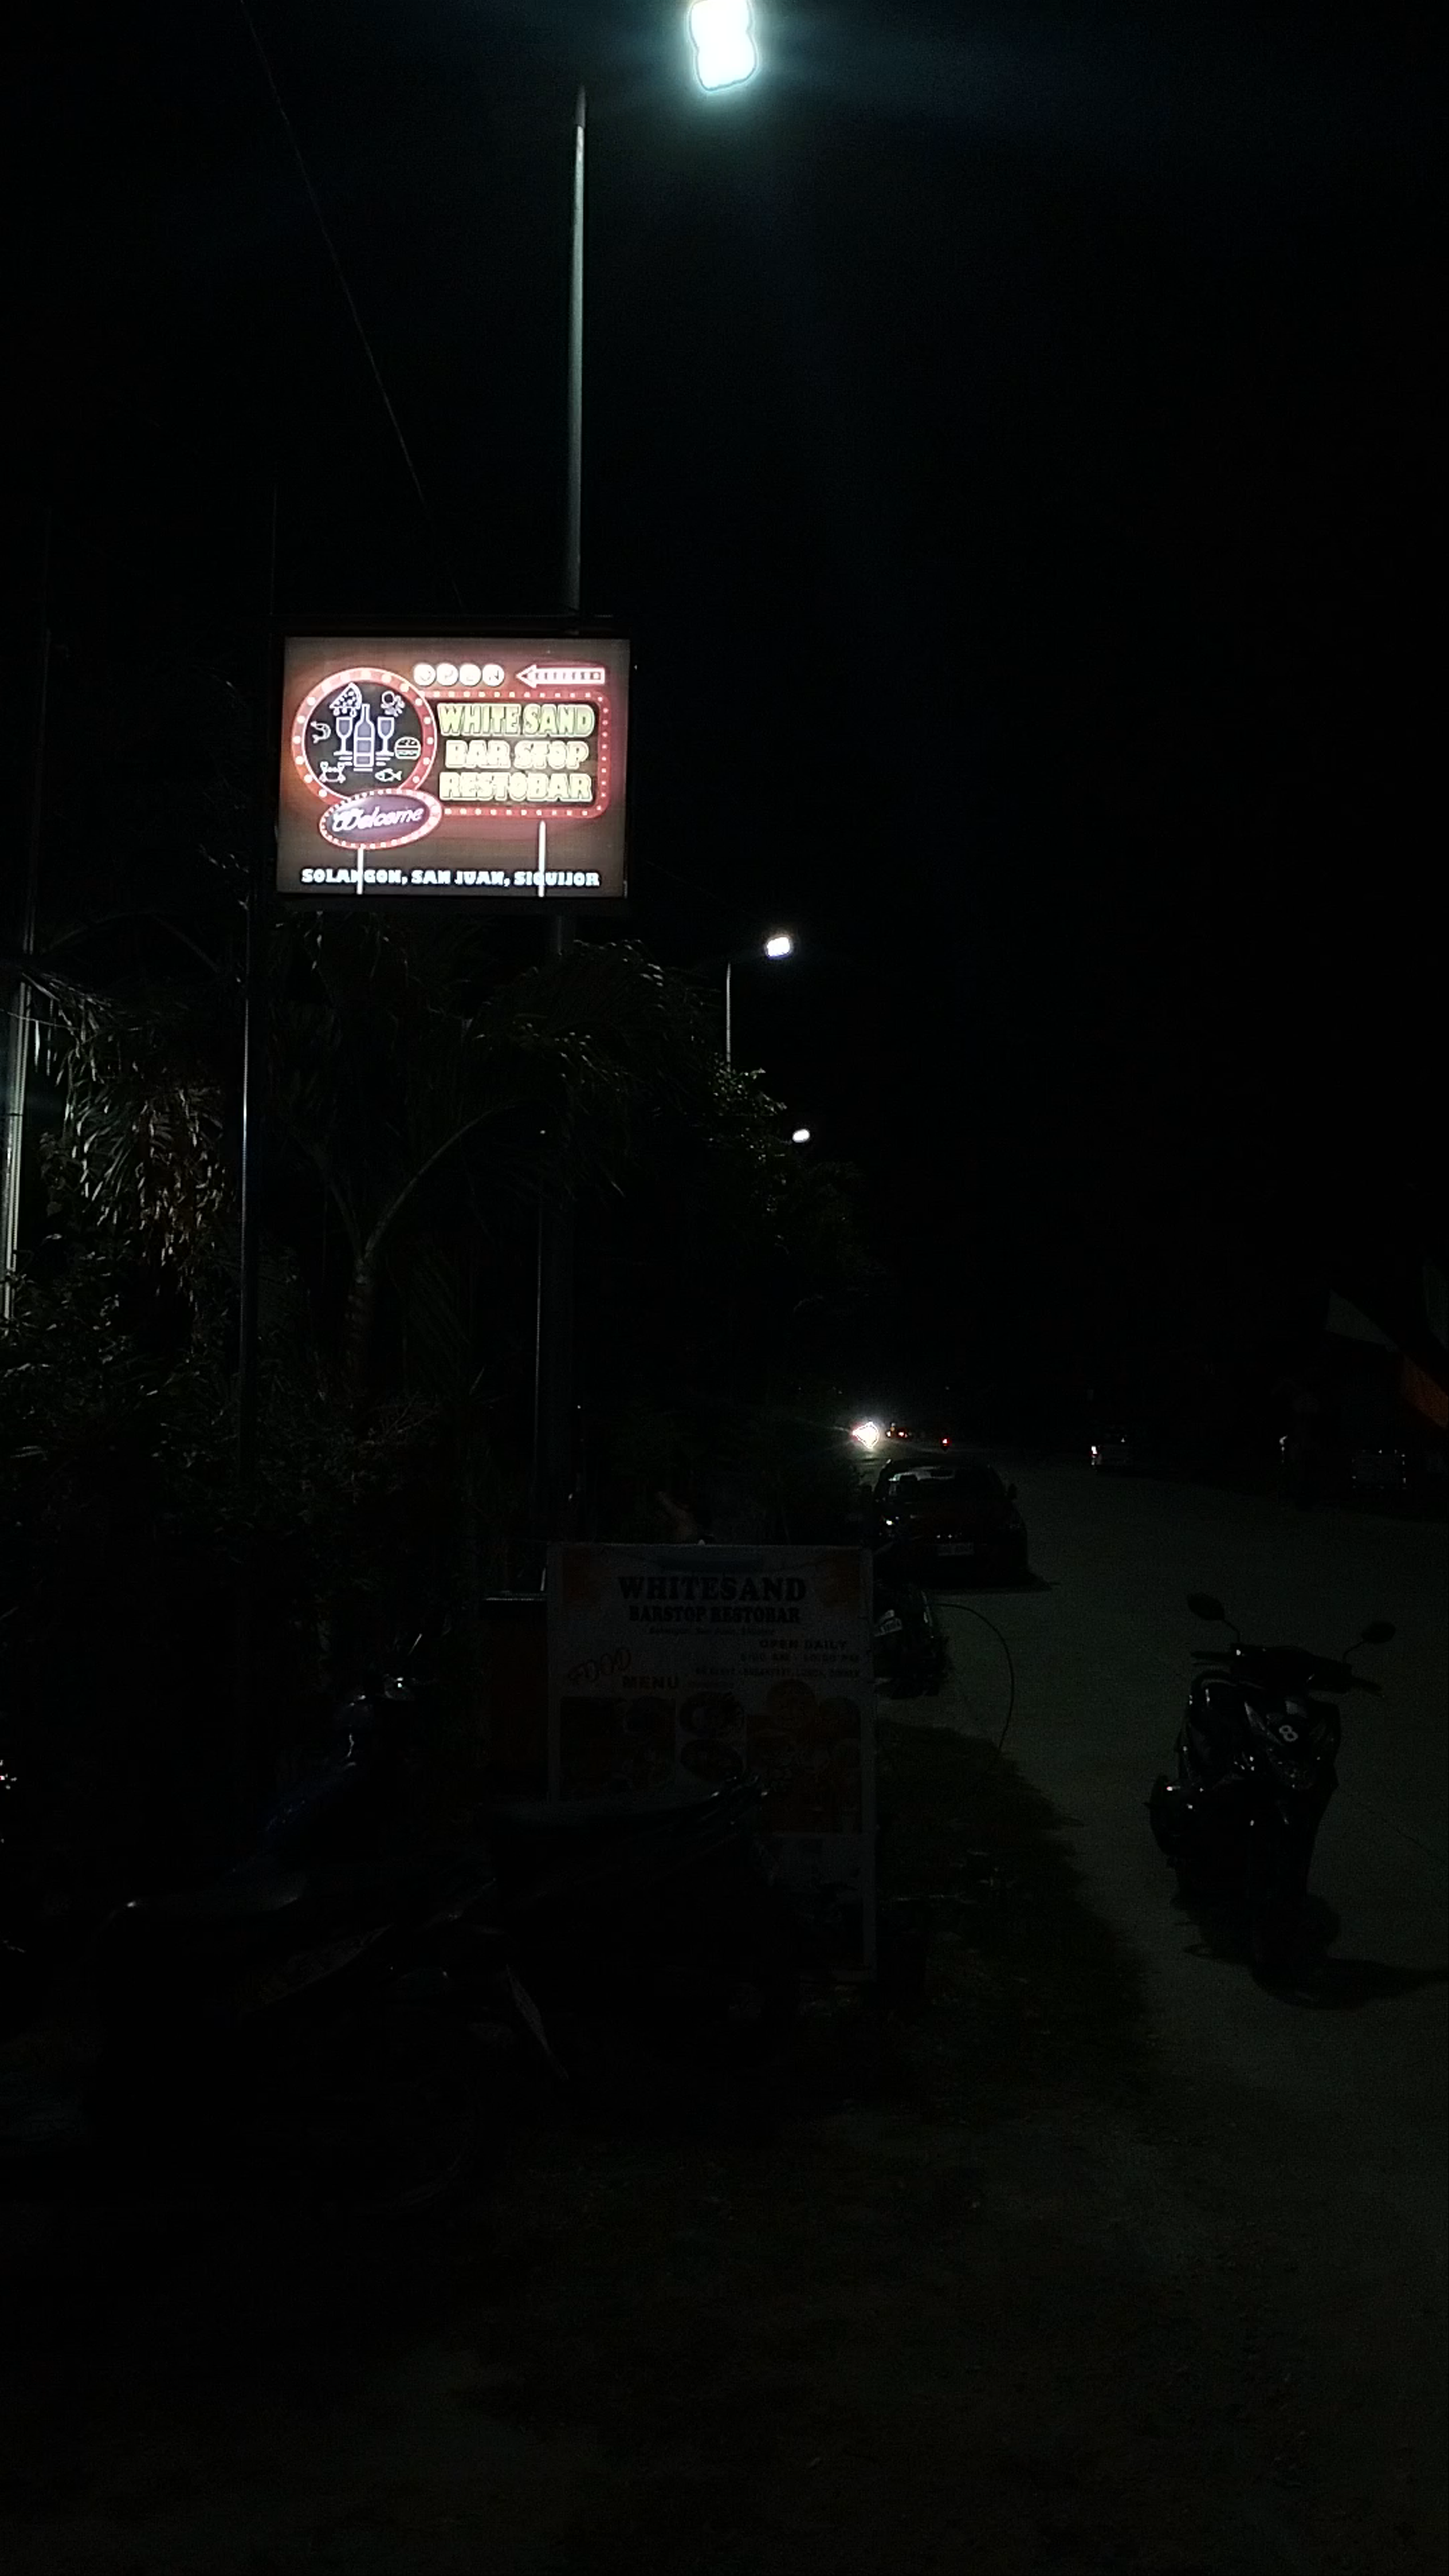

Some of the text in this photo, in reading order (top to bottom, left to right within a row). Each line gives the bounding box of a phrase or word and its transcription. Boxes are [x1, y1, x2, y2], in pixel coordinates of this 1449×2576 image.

[437, 703, 595, 737] WHITE SAND
[445, 740, 589, 769] BAR STOP
[439, 772, 593, 802] RESTOBAR
[332, 806, 424, 832] Welcome
[411, 870, 451, 885] SAN
[454, 870, 511, 887] JUAN,
[618, 1576, 806, 1601] WHITESAND
[629, 1606, 800, 1624] BARSTOP RESTOBAR
[759, 1639, 848, 1650] OPEN DAILY
[623, 1676, 680, 1689] MENU
[1278, 1724, 1298, 1742] 8
